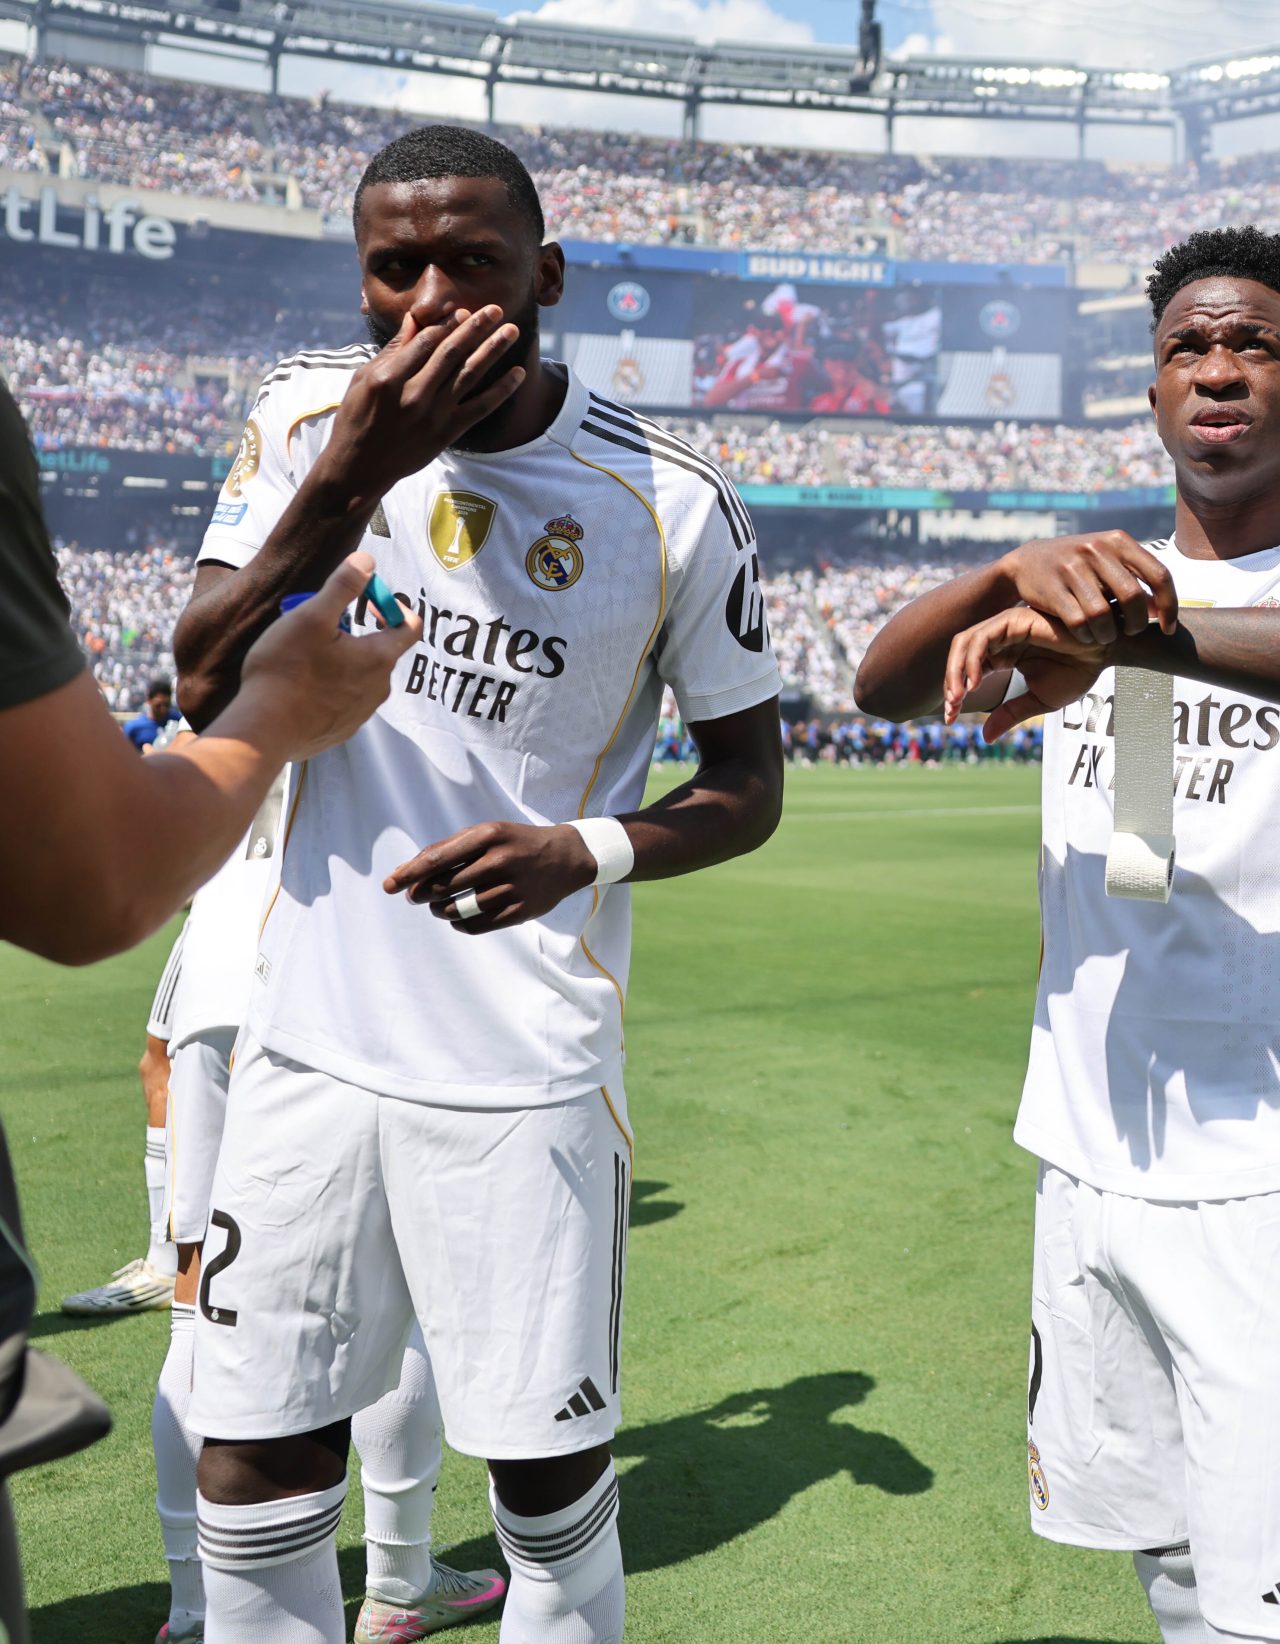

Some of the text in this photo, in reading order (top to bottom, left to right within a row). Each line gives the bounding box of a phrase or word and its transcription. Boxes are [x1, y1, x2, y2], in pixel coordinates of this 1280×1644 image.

[748, 256, 886, 282] BUD LIGHT
[405, 653, 517, 723] BETTER
